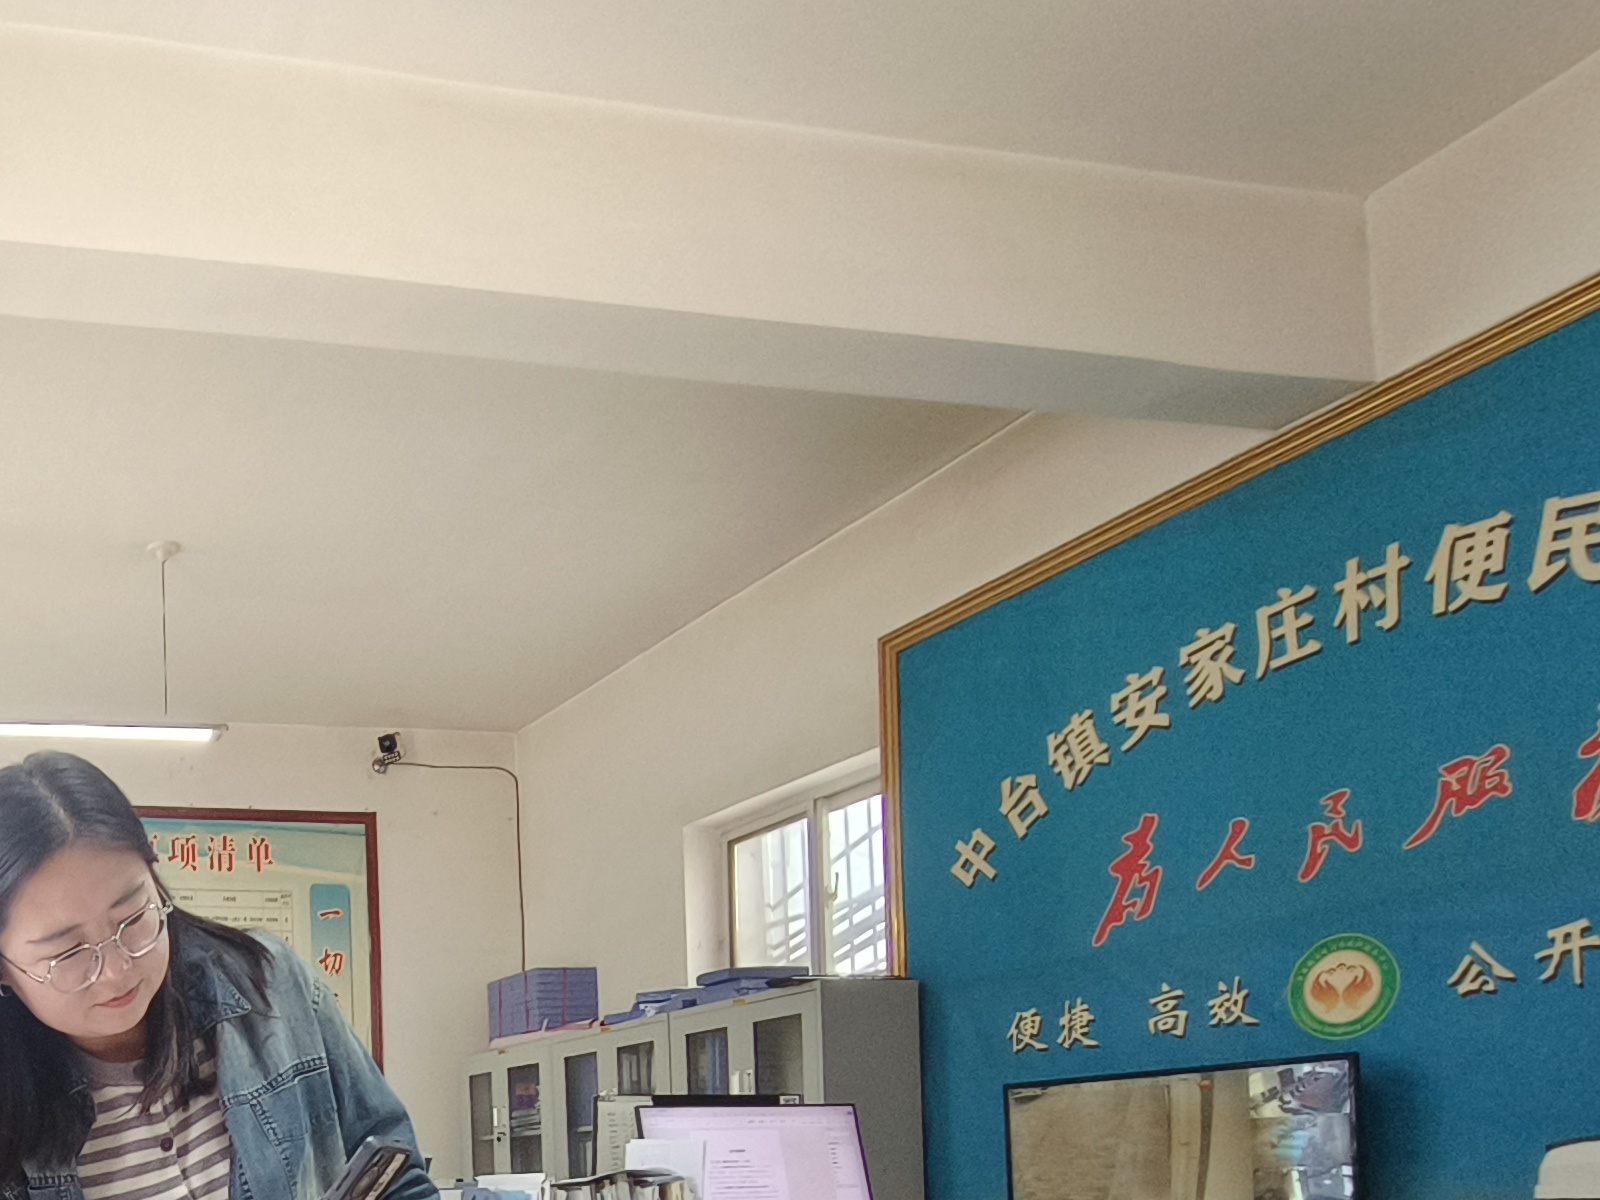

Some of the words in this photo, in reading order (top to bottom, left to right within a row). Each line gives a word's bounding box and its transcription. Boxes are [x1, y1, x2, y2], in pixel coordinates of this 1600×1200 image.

[949, 490, 1600, 889] 中台镇安家庄村便民
[318, 907, 345, 1003] 一切
[1006, 998, 1100, 1054] 便捷
[1147, 976, 1259, 1037] 高效
[1446, 918, 1600, 998] 公开
